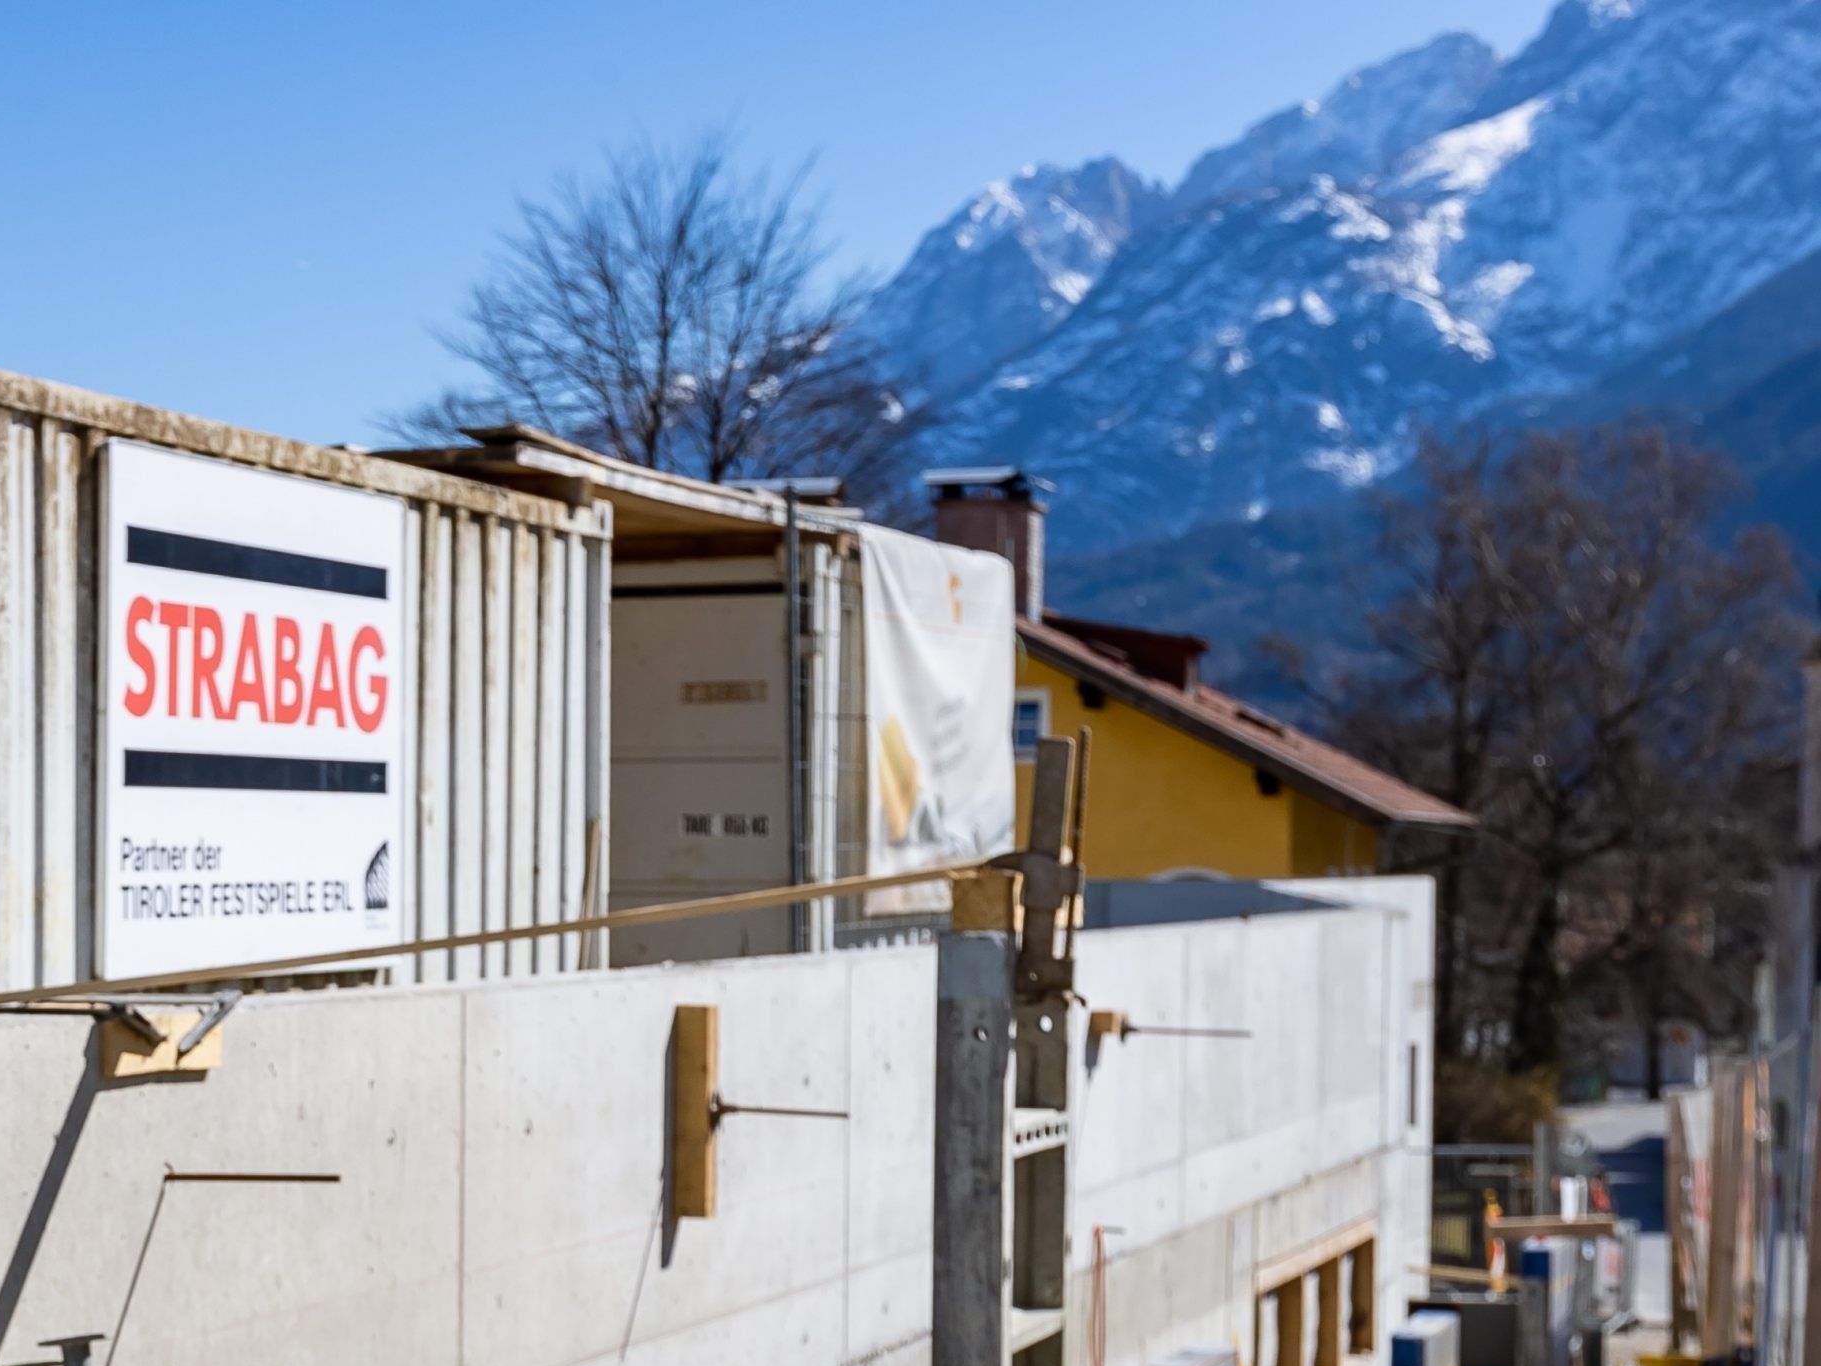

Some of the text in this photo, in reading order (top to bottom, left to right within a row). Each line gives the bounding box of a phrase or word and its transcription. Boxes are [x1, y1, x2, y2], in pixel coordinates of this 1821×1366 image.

[123, 595, 389, 734] STRABAG
[120, 836, 222, 872] Partner der
[120, 880, 354, 920] TIROLER FESTSPIELE ERL
